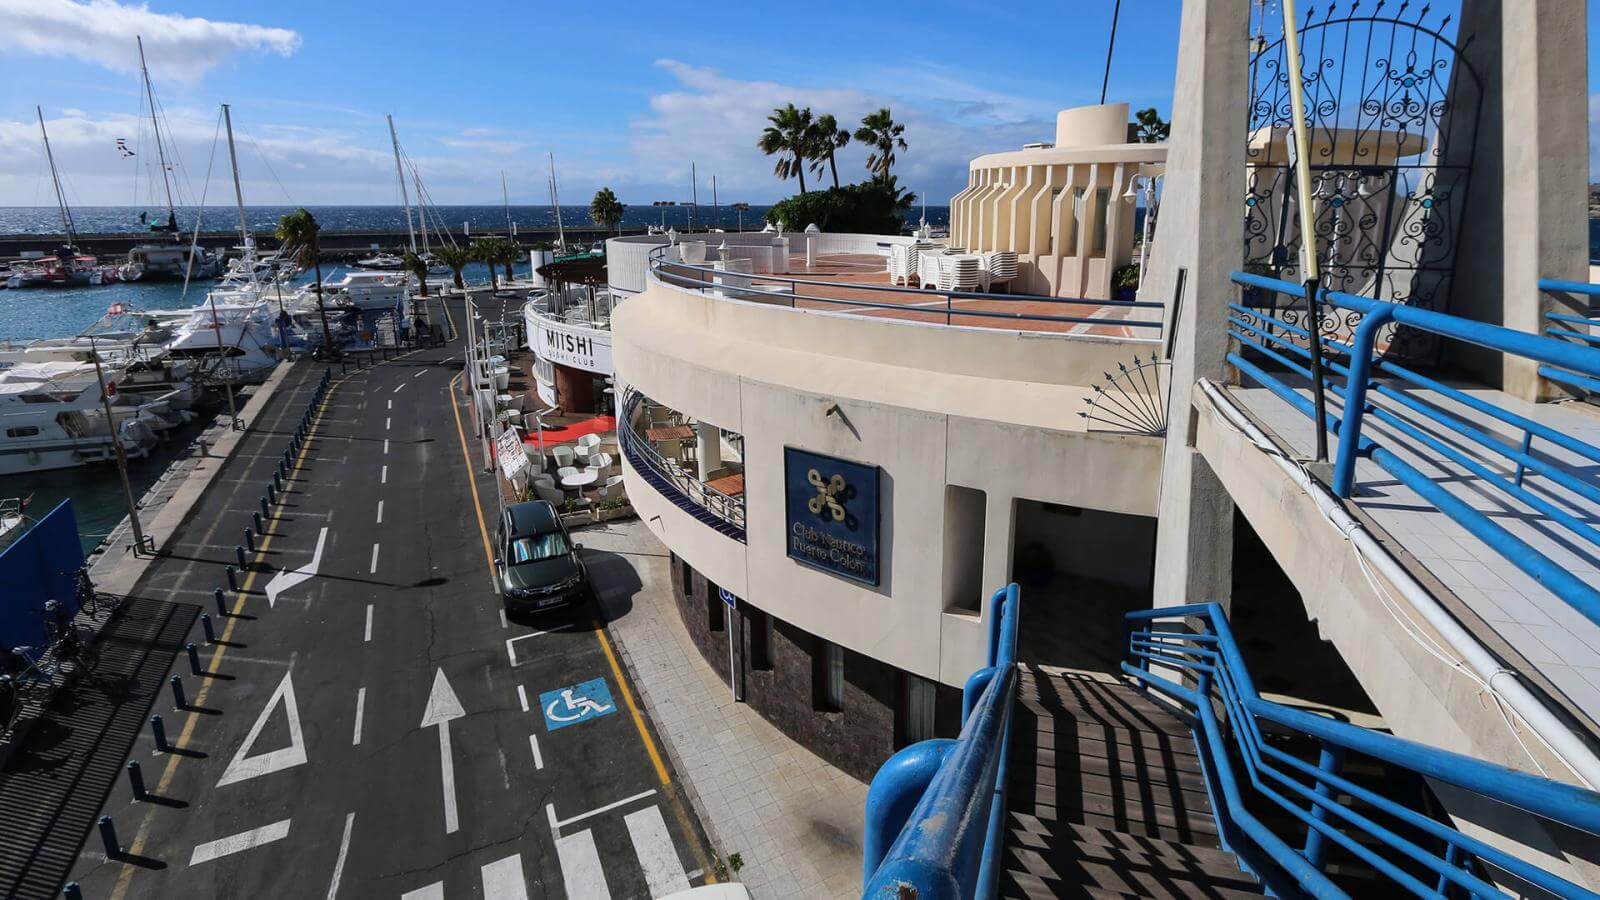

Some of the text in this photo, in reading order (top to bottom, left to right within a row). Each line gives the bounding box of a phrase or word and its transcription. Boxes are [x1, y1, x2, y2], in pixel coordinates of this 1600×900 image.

[546, 329, 593, 356] MIISHI
[572, 355, 594, 367] CLUB
[793, 521, 818, 541] Club
[792, 535, 827, 560] Puerto
